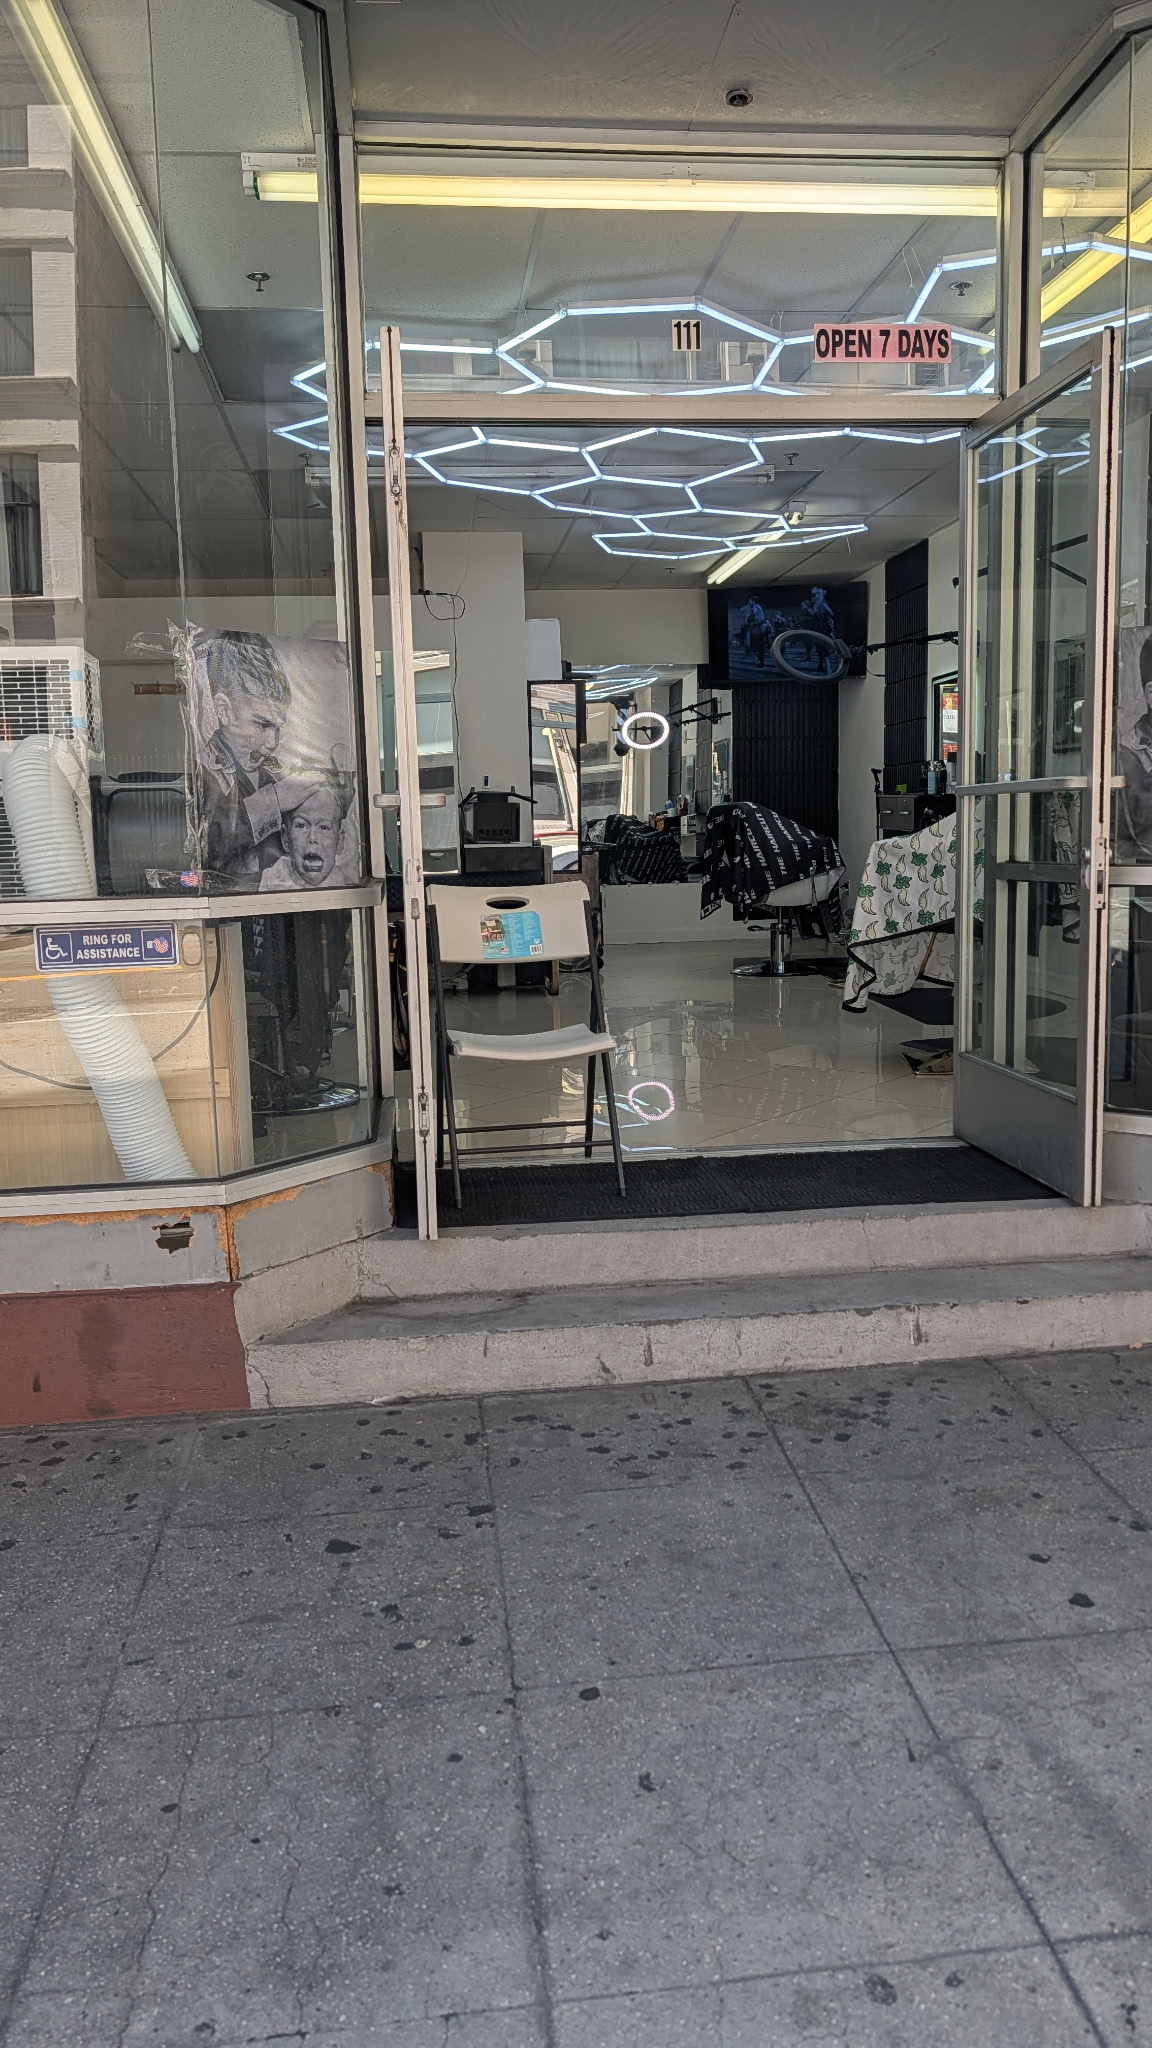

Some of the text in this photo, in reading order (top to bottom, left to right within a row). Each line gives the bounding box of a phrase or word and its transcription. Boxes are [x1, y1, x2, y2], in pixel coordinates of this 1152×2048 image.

[673, 321, 701, 350] 111
[815, 328, 950, 358] OPEN 7 DAYS
[770, 809, 794, 841] HAIRCU
[755, 811, 787, 876] THE HAIRCUT
[76, 946, 141, 960] ASSISTANCE
[82, 933, 132, 946] RING FOR
